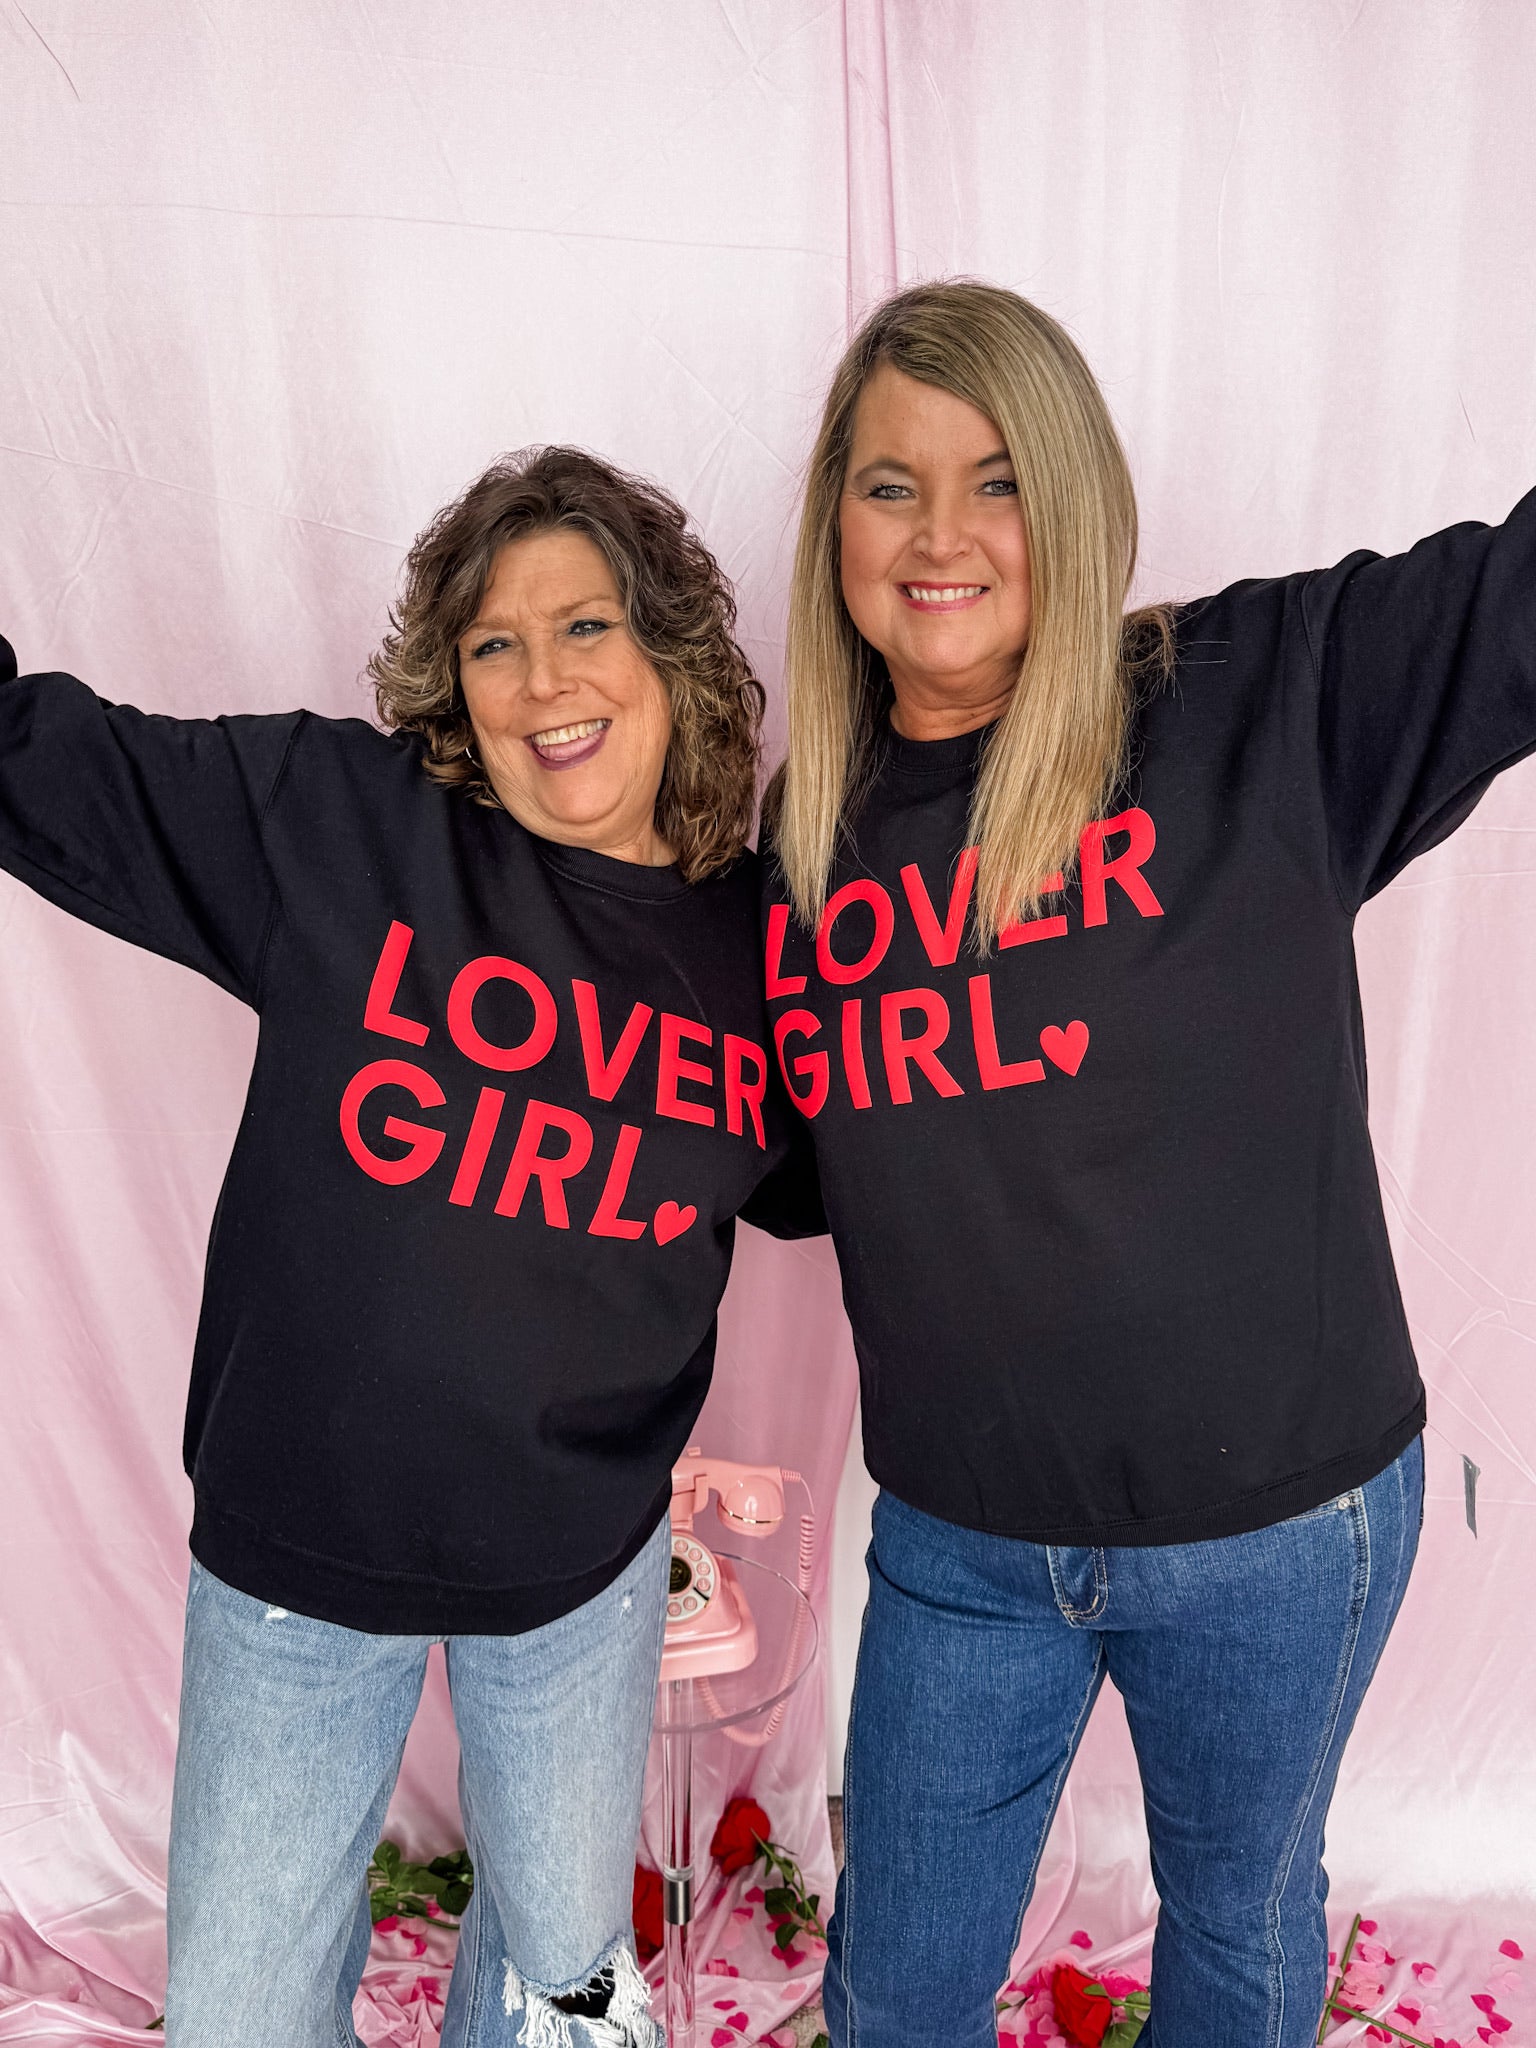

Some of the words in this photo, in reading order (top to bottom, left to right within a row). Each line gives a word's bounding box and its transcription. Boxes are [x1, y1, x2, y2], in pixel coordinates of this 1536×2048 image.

[364, 920, 767, 1151] LOVER
[774, 974, 1047, 1119] GIRL
[340, 1059, 648, 1241] GIRL
